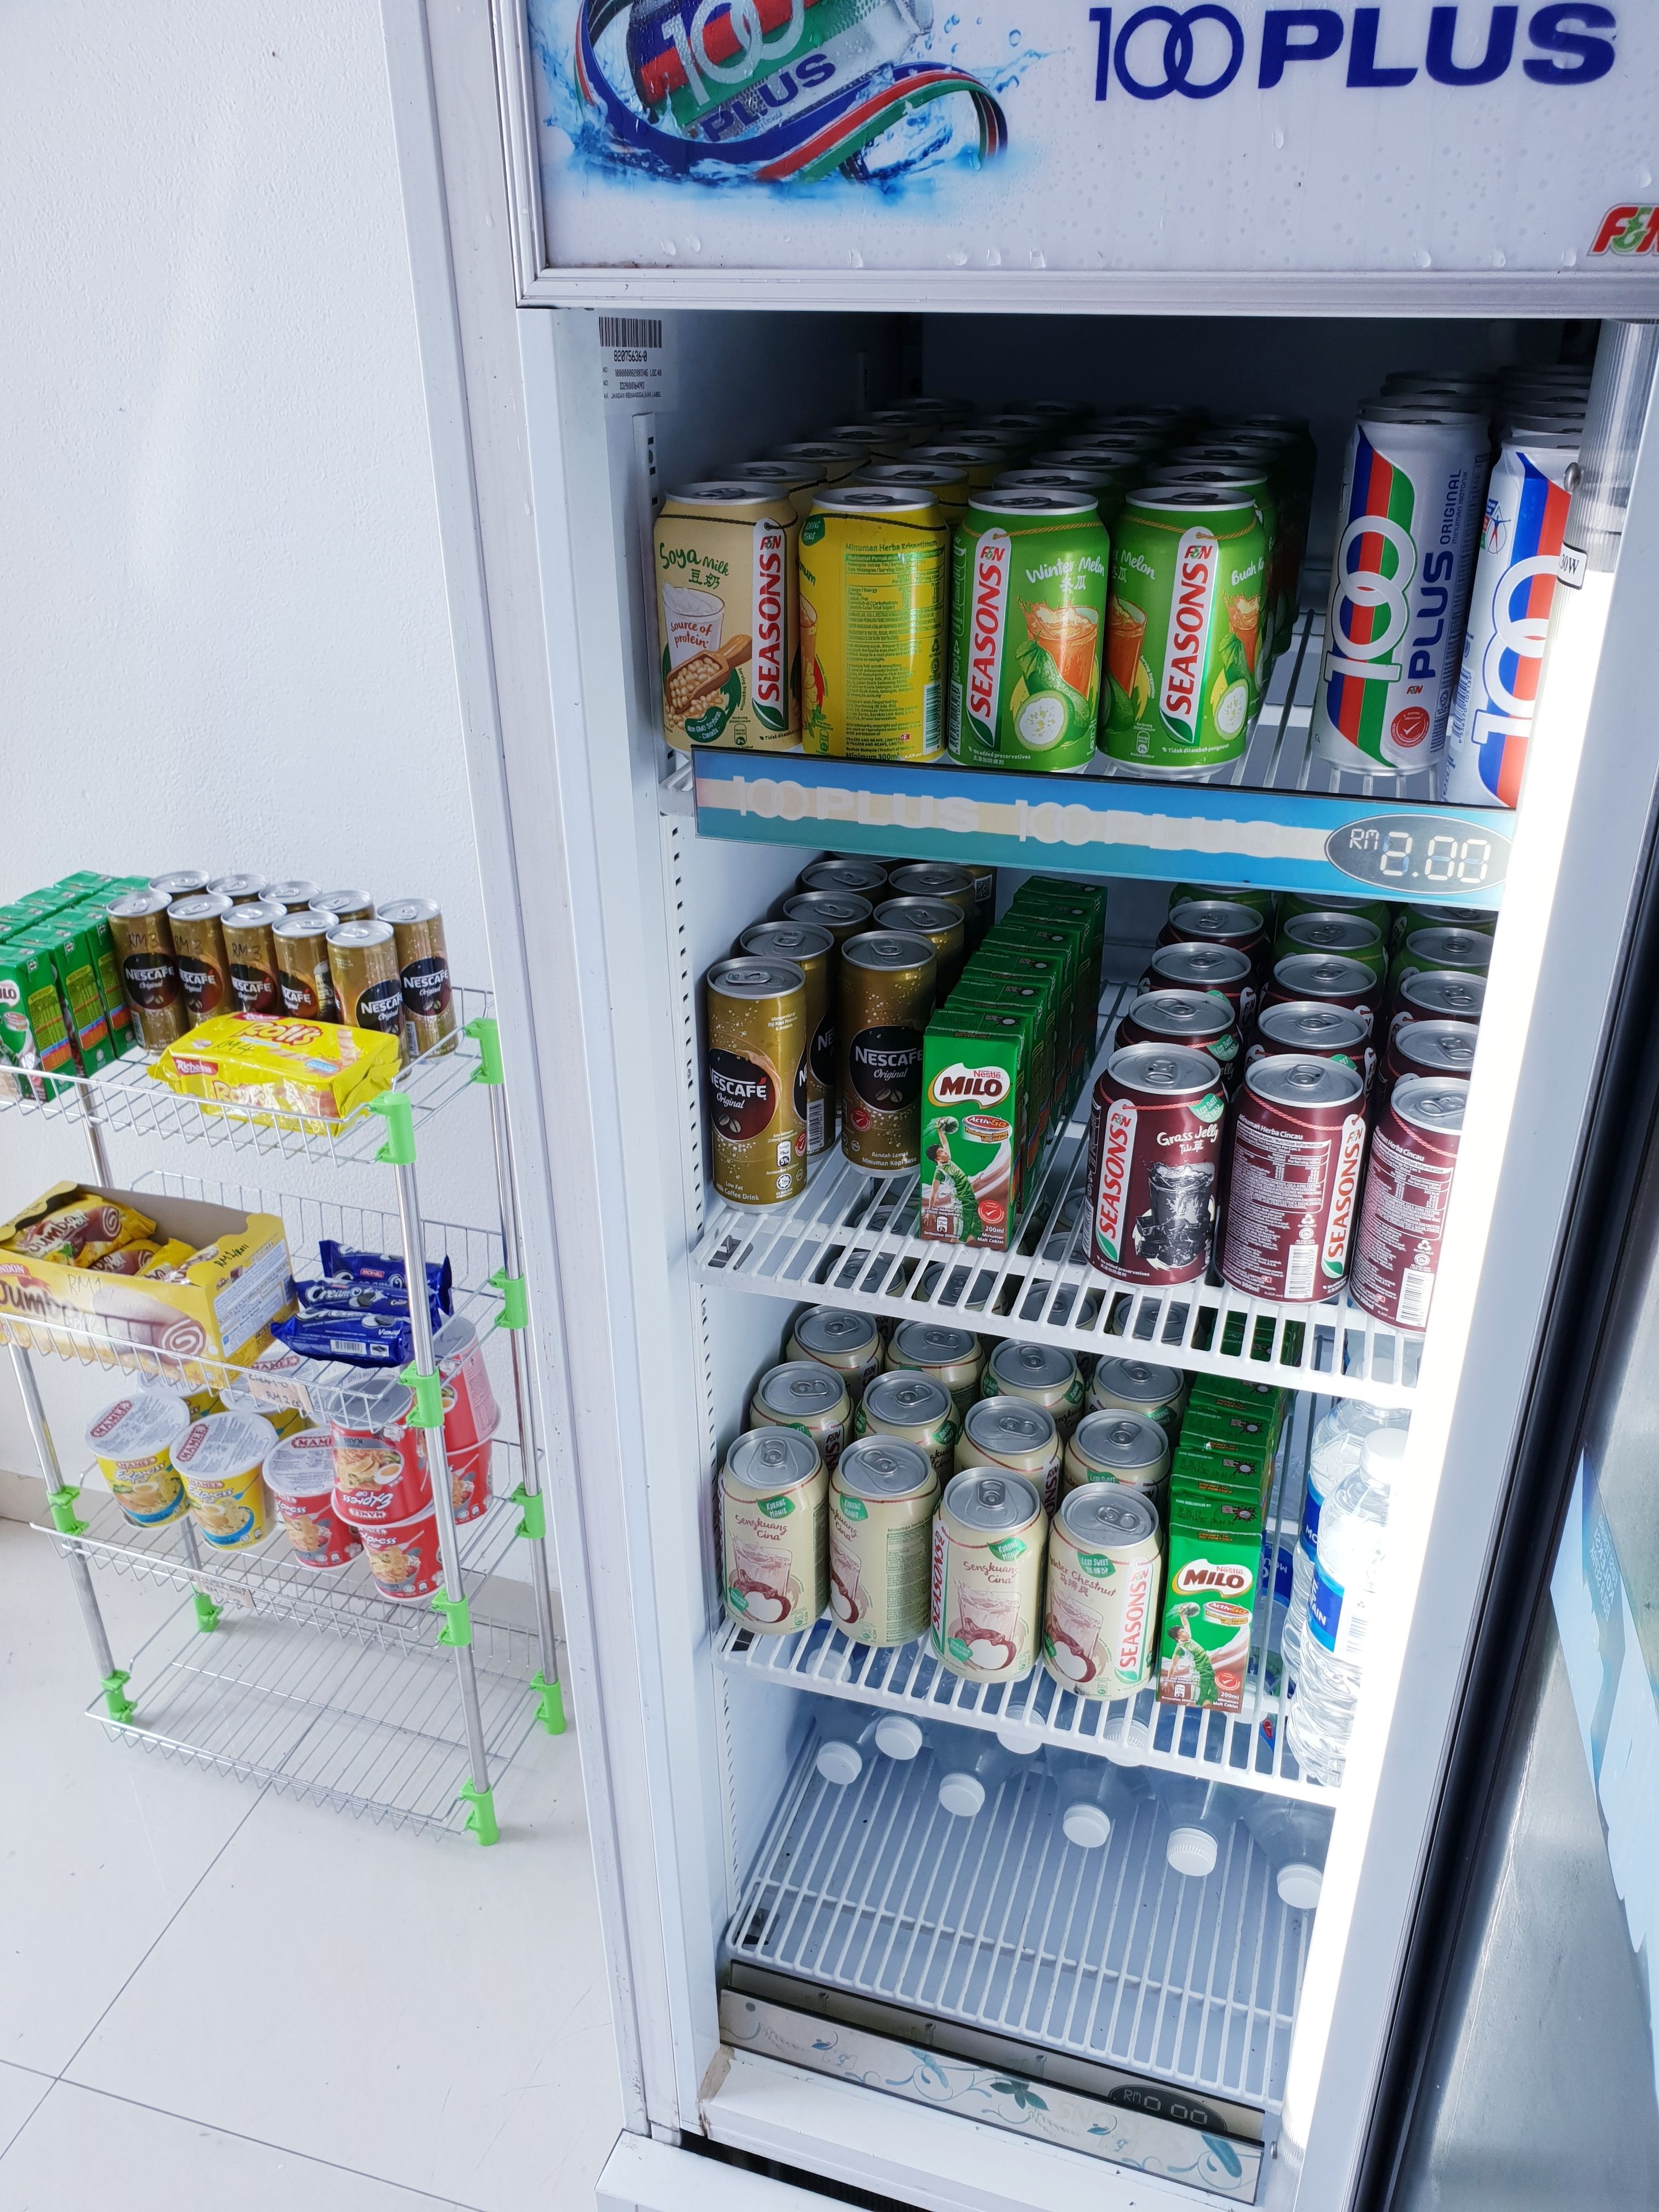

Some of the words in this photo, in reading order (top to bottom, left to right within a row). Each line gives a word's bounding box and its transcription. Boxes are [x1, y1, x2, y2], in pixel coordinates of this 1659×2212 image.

[699, 53, 836, 142] PLUS
[614, 350, 647, 362] 82075636-0
[1440, 469, 1461, 545] ORIGINAL
[845, 543, 878, 552] Minuman
[980, 545, 1005, 562] F&N
[1184, 544, 1213, 560] F&N
[660, 542, 702, 569] Soya
[702, 556, 729, 576] Milk
[1120, 550, 1156, 581] Melon
[688, 569, 720, 589] 豆奶
[1026, 559, 1073, 584] Winter
[1079, 556, 1105, 578] Melon
[1231, 565, 1256, 587] Buah
[1059, 575, 1087, 592] 冬瓜
[1324, 516, 1418, 683] 100
[1408, 551, 1455, 680] PLUS
[671, 621, 698, 632] source
[699, 623, 713, 636] of
[759, 552, 781, 702] SEASONS
[969, 562, 1002, 718] SEASONS
[1165, 562, 1209, 716] SEASONS
[994, 752, 1031, 760] preservatives
[1349, 828, 1379, 851] RM
[1381, 832, 1491, 884] 2.00
[232, 942, 248, 958] RM
[419, 986, 441, 997] Original
[873, 1067, 908, 1081] Original
[1220, 1063, 1234, 1080] elly
[940, 1076, 1003, 1097] MILO
[717, 1093, 745, 1109] Original
[1111, 1112, 1132, 1128] F&N
[1238, 1113, 1260, 1130] Minuman
[1260, 1125, 1280, 1137] Herba
[1280, 1130, 1303, 1140] Cincau
[1157, 1131, 1194, 1146] Grass
[1194, 1124, 1218, 1142] Jelly
[1179, 1140, 1204, 1154] 仙草
[1387, 1139, 1403, 1153] Herba
[1403, 1147, 1425, 1161] Cincau
[780, 1157, 789, 1166] 5%
[862, 1157, 889, 1166] Minuman
[890, 1158, 903, 1166] Kopi
[1098, 1127, 1127, 1240] SEASONS
[725, 1188, 741, 1198] Coffee
[1328, 1140, 1359, 1258] SEASONS
[1106, 1261, 1118, 1270] added
[1118, 1266, 1150, 1277] preservatives
[1241, 1282, 1259, 1293] 300ml
[266, 1390, 282, 1403] RM
[93, 1402, 131, 1437] MAMEE
[180, 1426, 207, 1461] MAMEE
[115, 1462, 166, 1484] Express
[188, 1485, 234, 1503] Express
[343, 1491, 393, 1510] Express
[351, 1508, 385, 1518] MAMEE
[770, 1509, 787, 1518] MANIS
[735, 1514, 789, 1535] Sengkuang
[835, 1521, 853, 1541] Cina
[756, 1530, 781, 1541] Cina
[963, 1561, 1020, 1578] Sengkuang
[1081, 1558, 1092, 1566] LESS
[1093, 1558, 1108, 1566] SWEET
[933, 1539, 944, 1630] SEASONS
[988, 1574, 1013, 1584] Cina
[1050, 1554, 1069, 1575] Water
[1071, 1570, 1118, 1598] Chestnut
[1183, 1569, 1244, 1589] MILO
[1119, 1581, 1146, 1668] SEASONS
[1221, 1691, 1239, 1700] 200ml
[1124, 2089, 1141, 2104] RM
